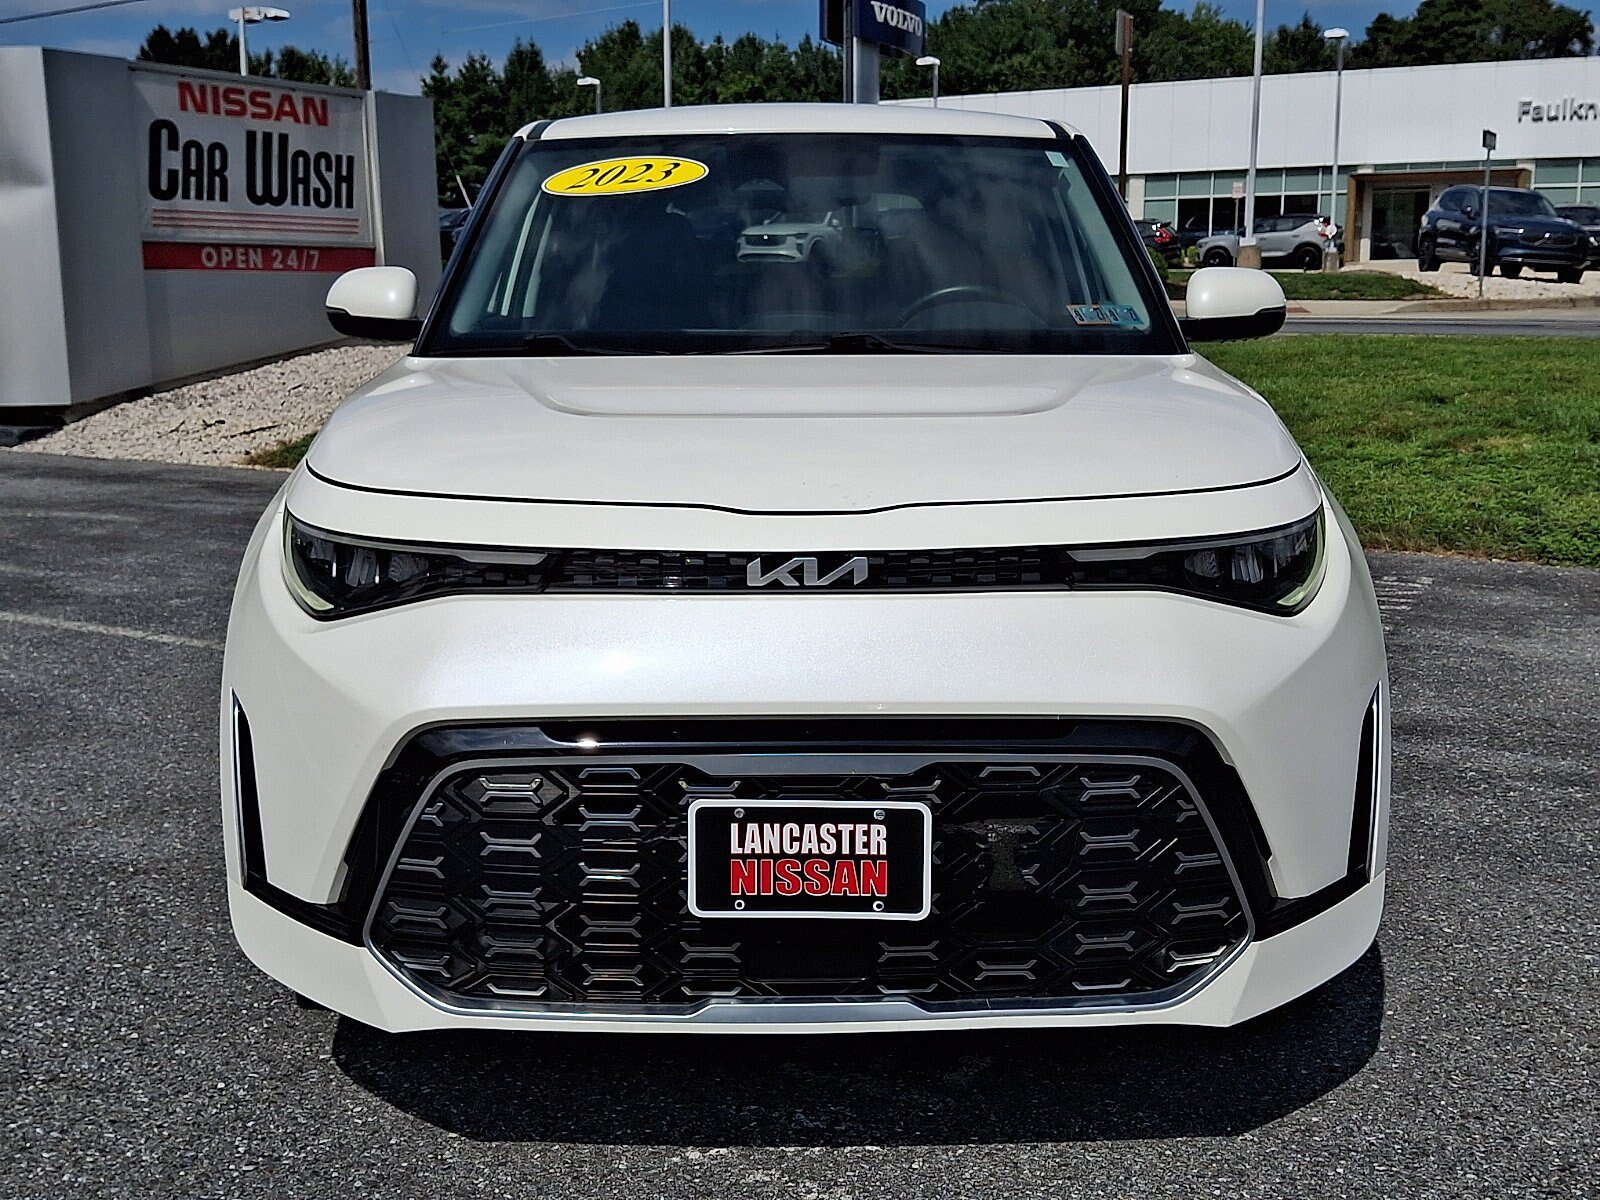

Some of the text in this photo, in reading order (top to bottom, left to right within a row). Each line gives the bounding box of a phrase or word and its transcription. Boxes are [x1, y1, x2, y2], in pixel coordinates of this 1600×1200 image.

[870, 0, 923, 37] VOLVO
[178, 80, 329, 126] NISSAN
[1518, 98, 1600, 123] Faulkn
[148, 119, 354, 209] CAR WASH
[564, 162, 681, 190] 2023
[202, 246, 320, 271] OPEN 24/7
[747, 557, 868, 586] KIA
[730, 823, 887, 855] LANCASTER
[730, 859, 888, 897] NISSAN
